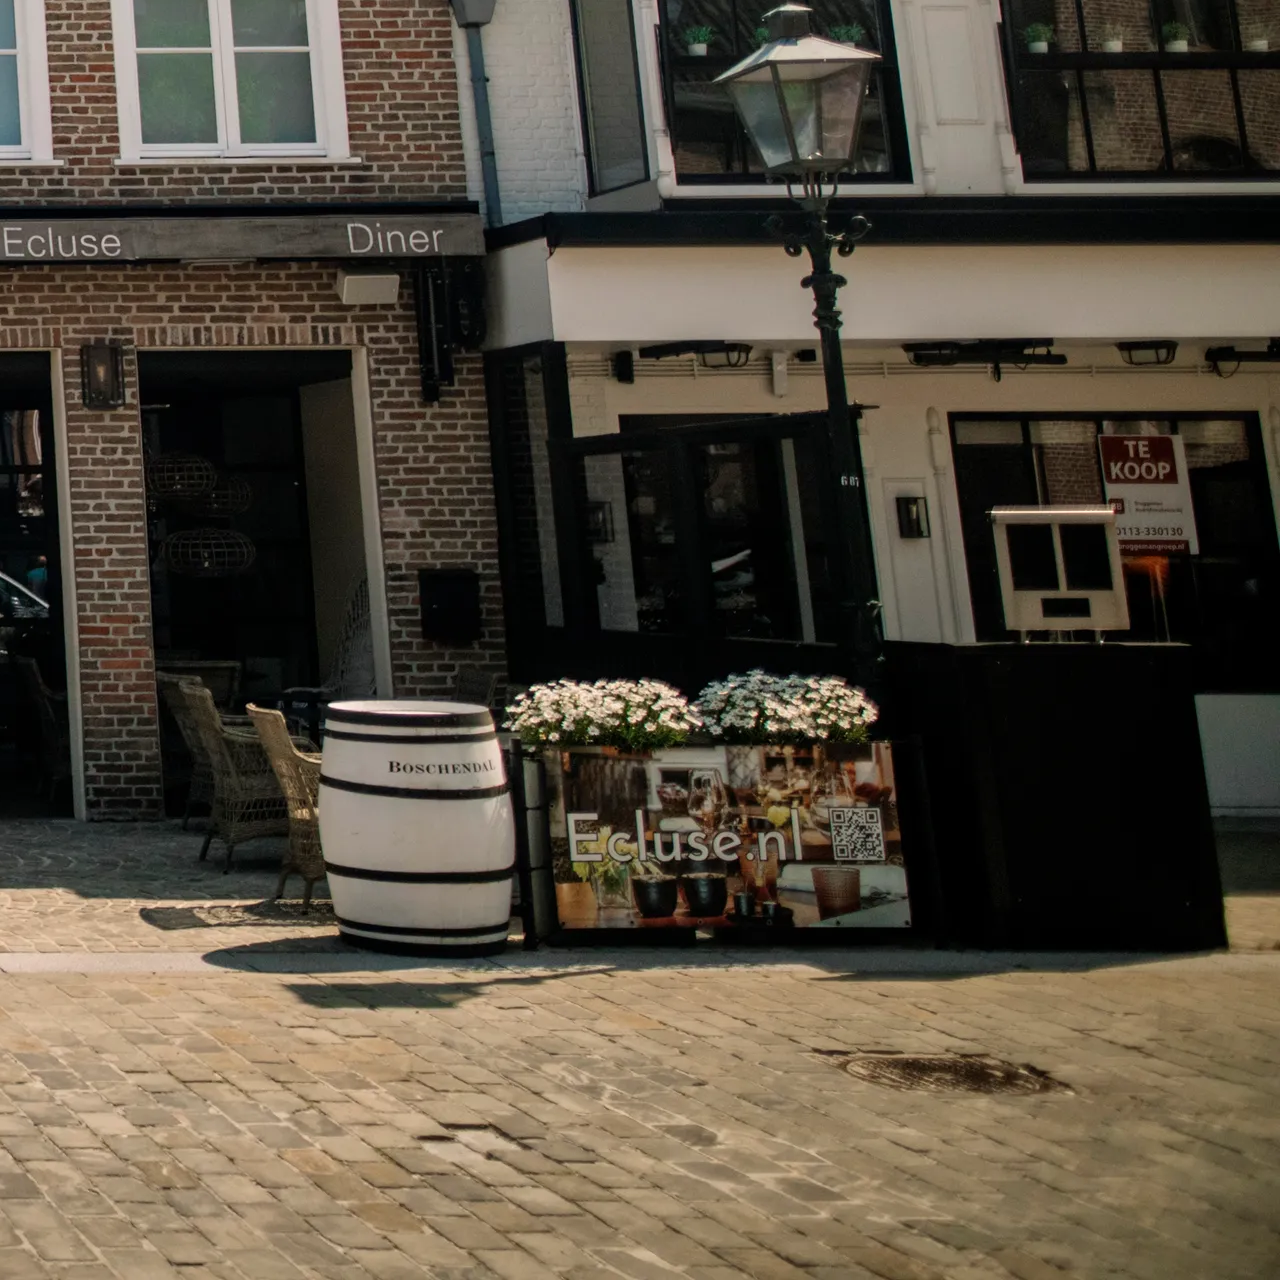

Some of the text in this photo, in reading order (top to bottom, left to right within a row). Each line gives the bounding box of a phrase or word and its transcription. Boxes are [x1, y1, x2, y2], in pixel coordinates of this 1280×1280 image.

[2, 226, 121, 259] Ecluse
[346, 222, 444, 254] Diner
[1123, 440, 1151, 458] TE
[1109, 461, 1172, 480] KOOP
[387, 759, 496, 775] BOSCHENDAL
[566, 808, 804, 862] Ecluse.nl
